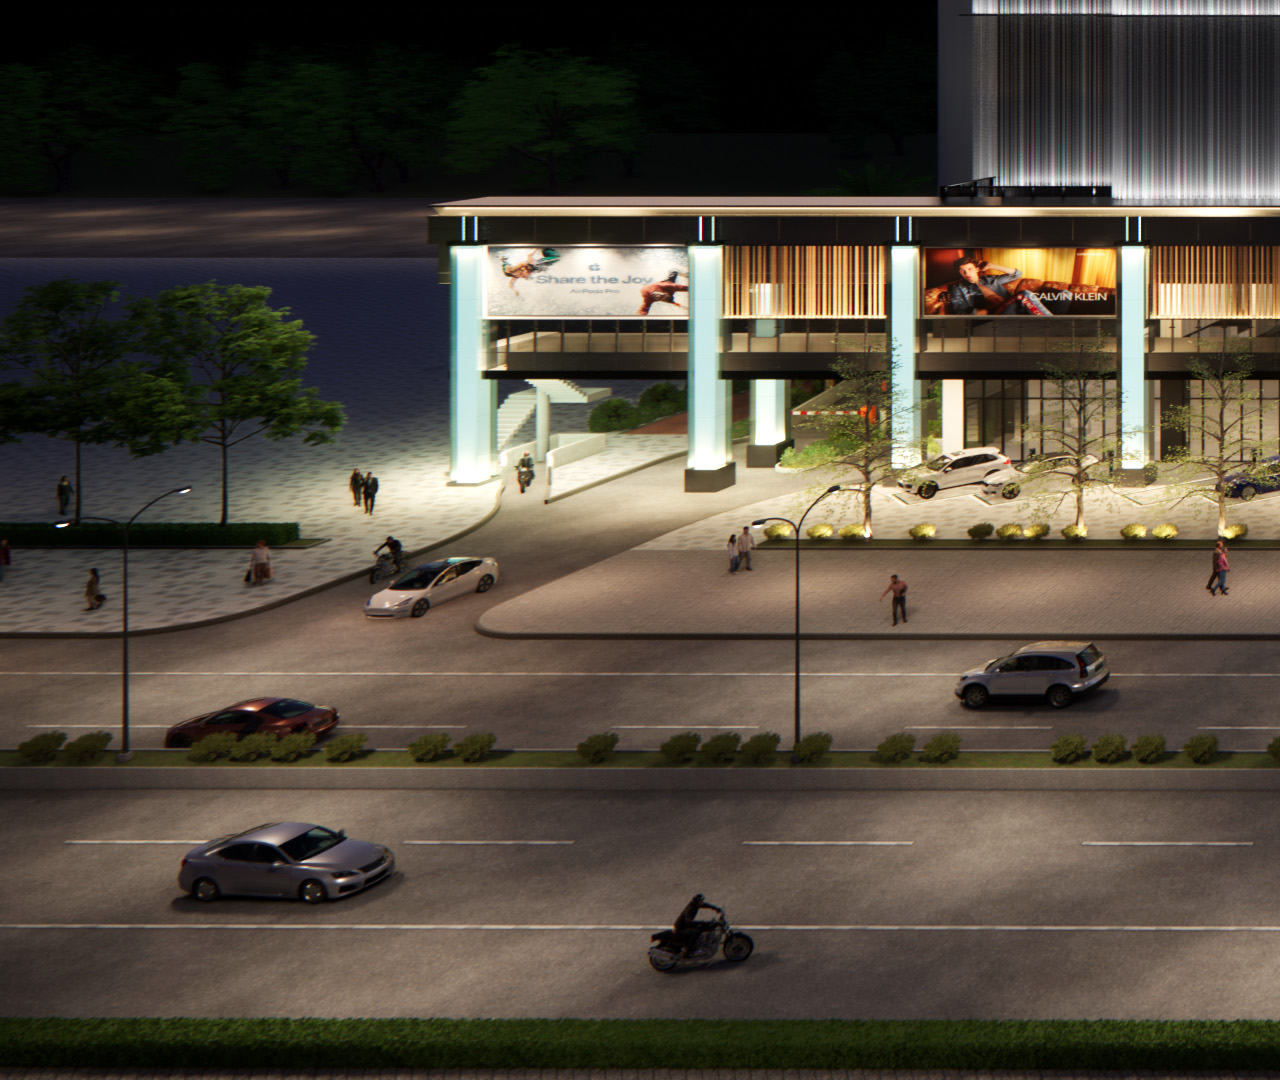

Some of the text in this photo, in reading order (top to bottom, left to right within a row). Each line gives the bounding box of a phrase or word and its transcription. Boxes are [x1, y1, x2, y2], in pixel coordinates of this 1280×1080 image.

[536, 275, 654, 286] Share the Joy
[1030, 292, 1108, 301] CALVIN KLEIN
